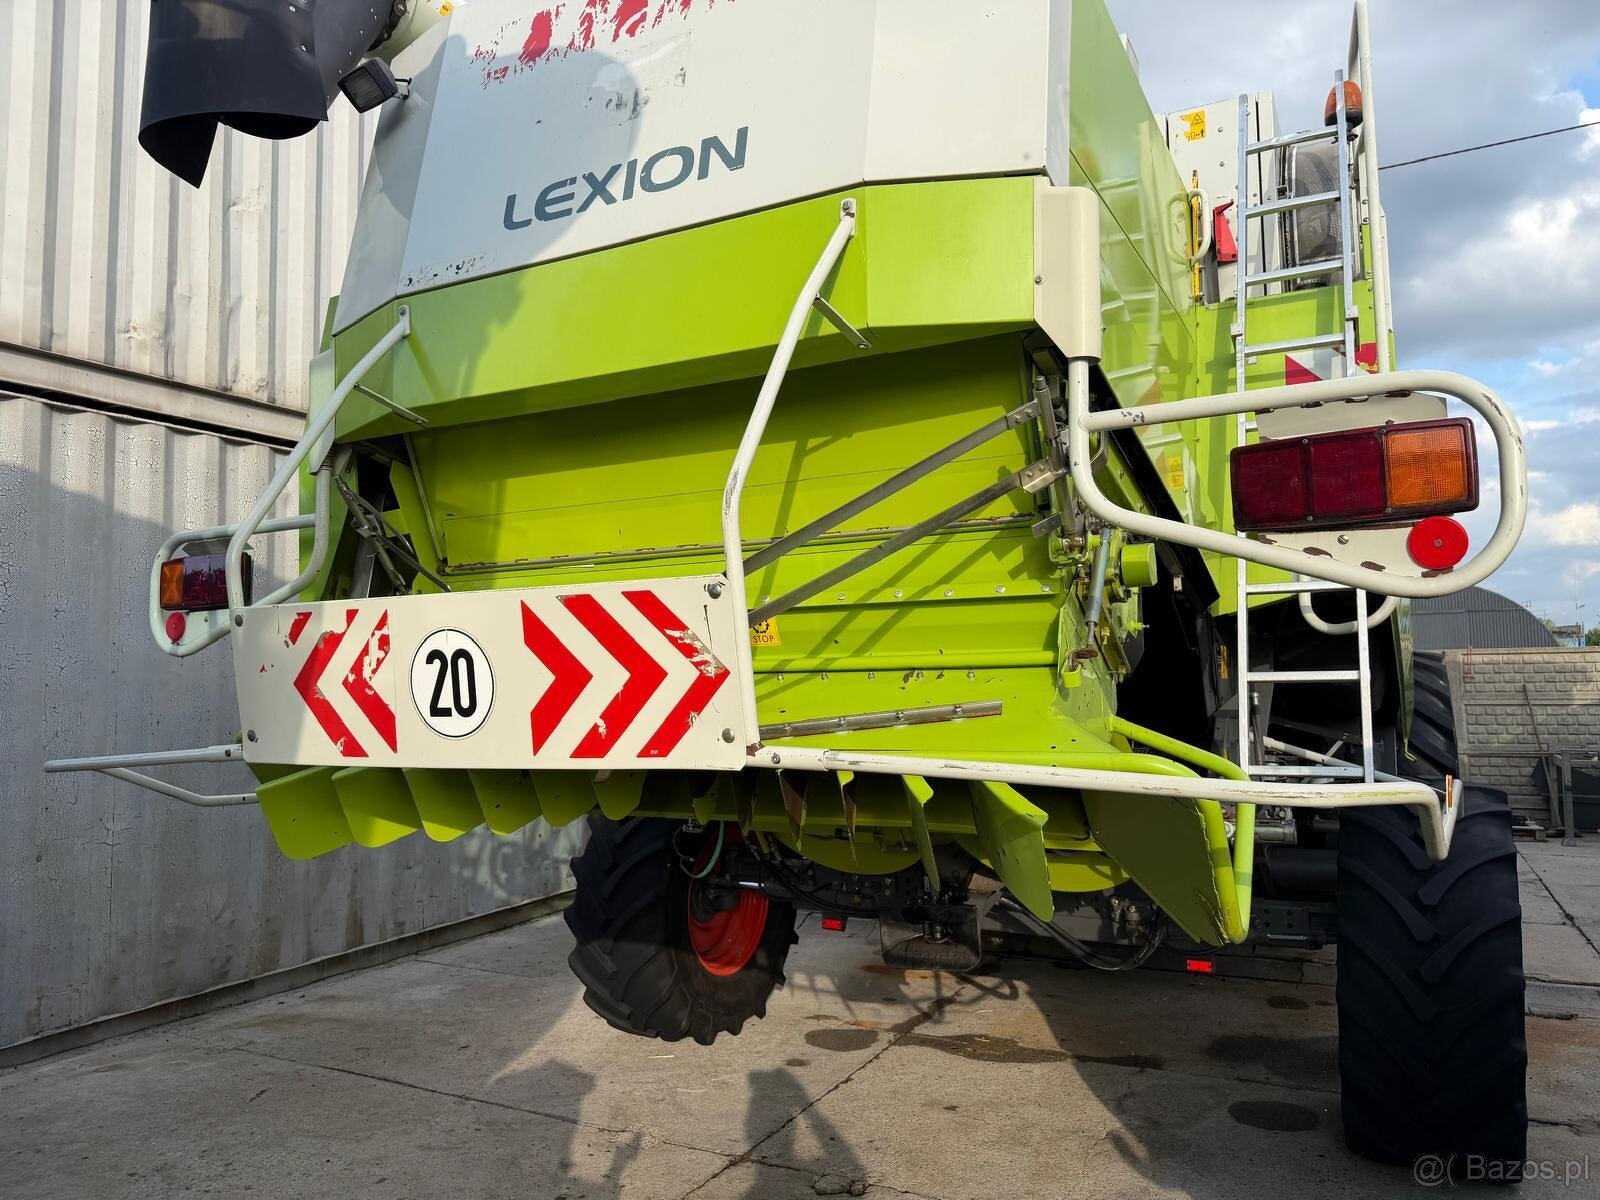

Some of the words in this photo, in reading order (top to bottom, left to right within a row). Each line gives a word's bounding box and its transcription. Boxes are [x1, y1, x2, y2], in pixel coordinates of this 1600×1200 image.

[503, 126, 748, 230] LEXION
[752, 634, 774, 643] STOP
[425, 648, 477, 718] 20
